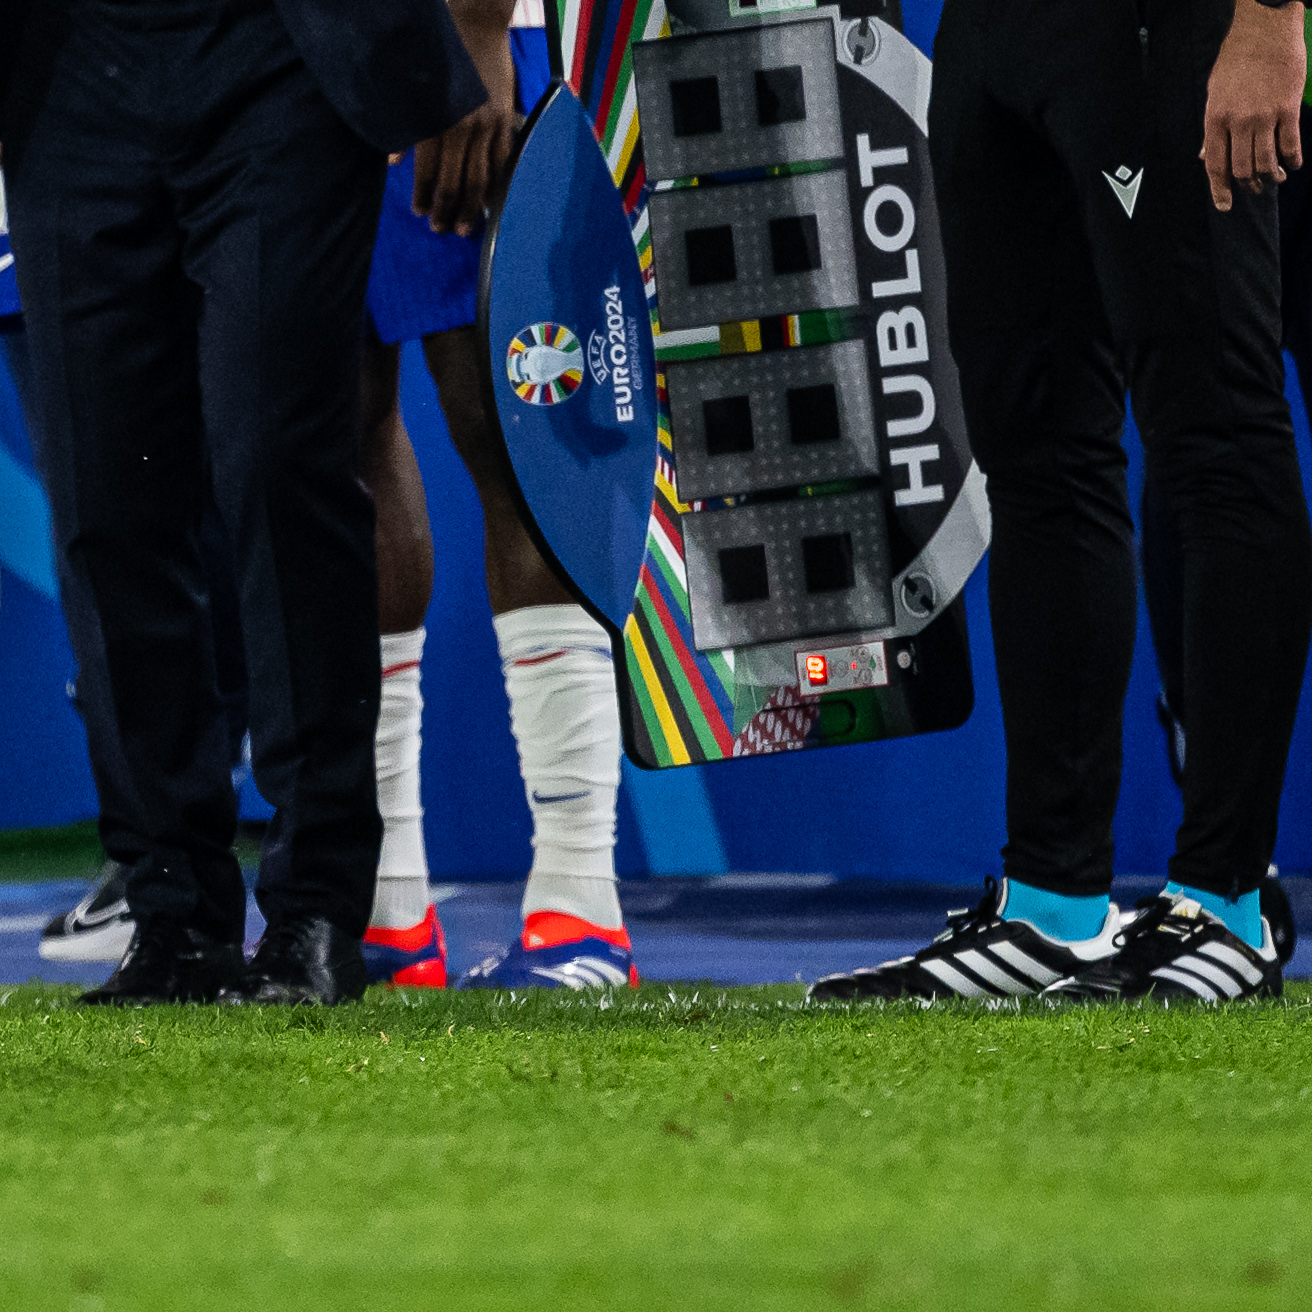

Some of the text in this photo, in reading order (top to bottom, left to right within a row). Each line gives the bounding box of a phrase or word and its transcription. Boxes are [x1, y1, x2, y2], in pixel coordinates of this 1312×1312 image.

[589, 331, 608, 385] UEFA
[603, 285, 634, 423] EURO2024
[856, 132, 945, 507] HUBLOT
